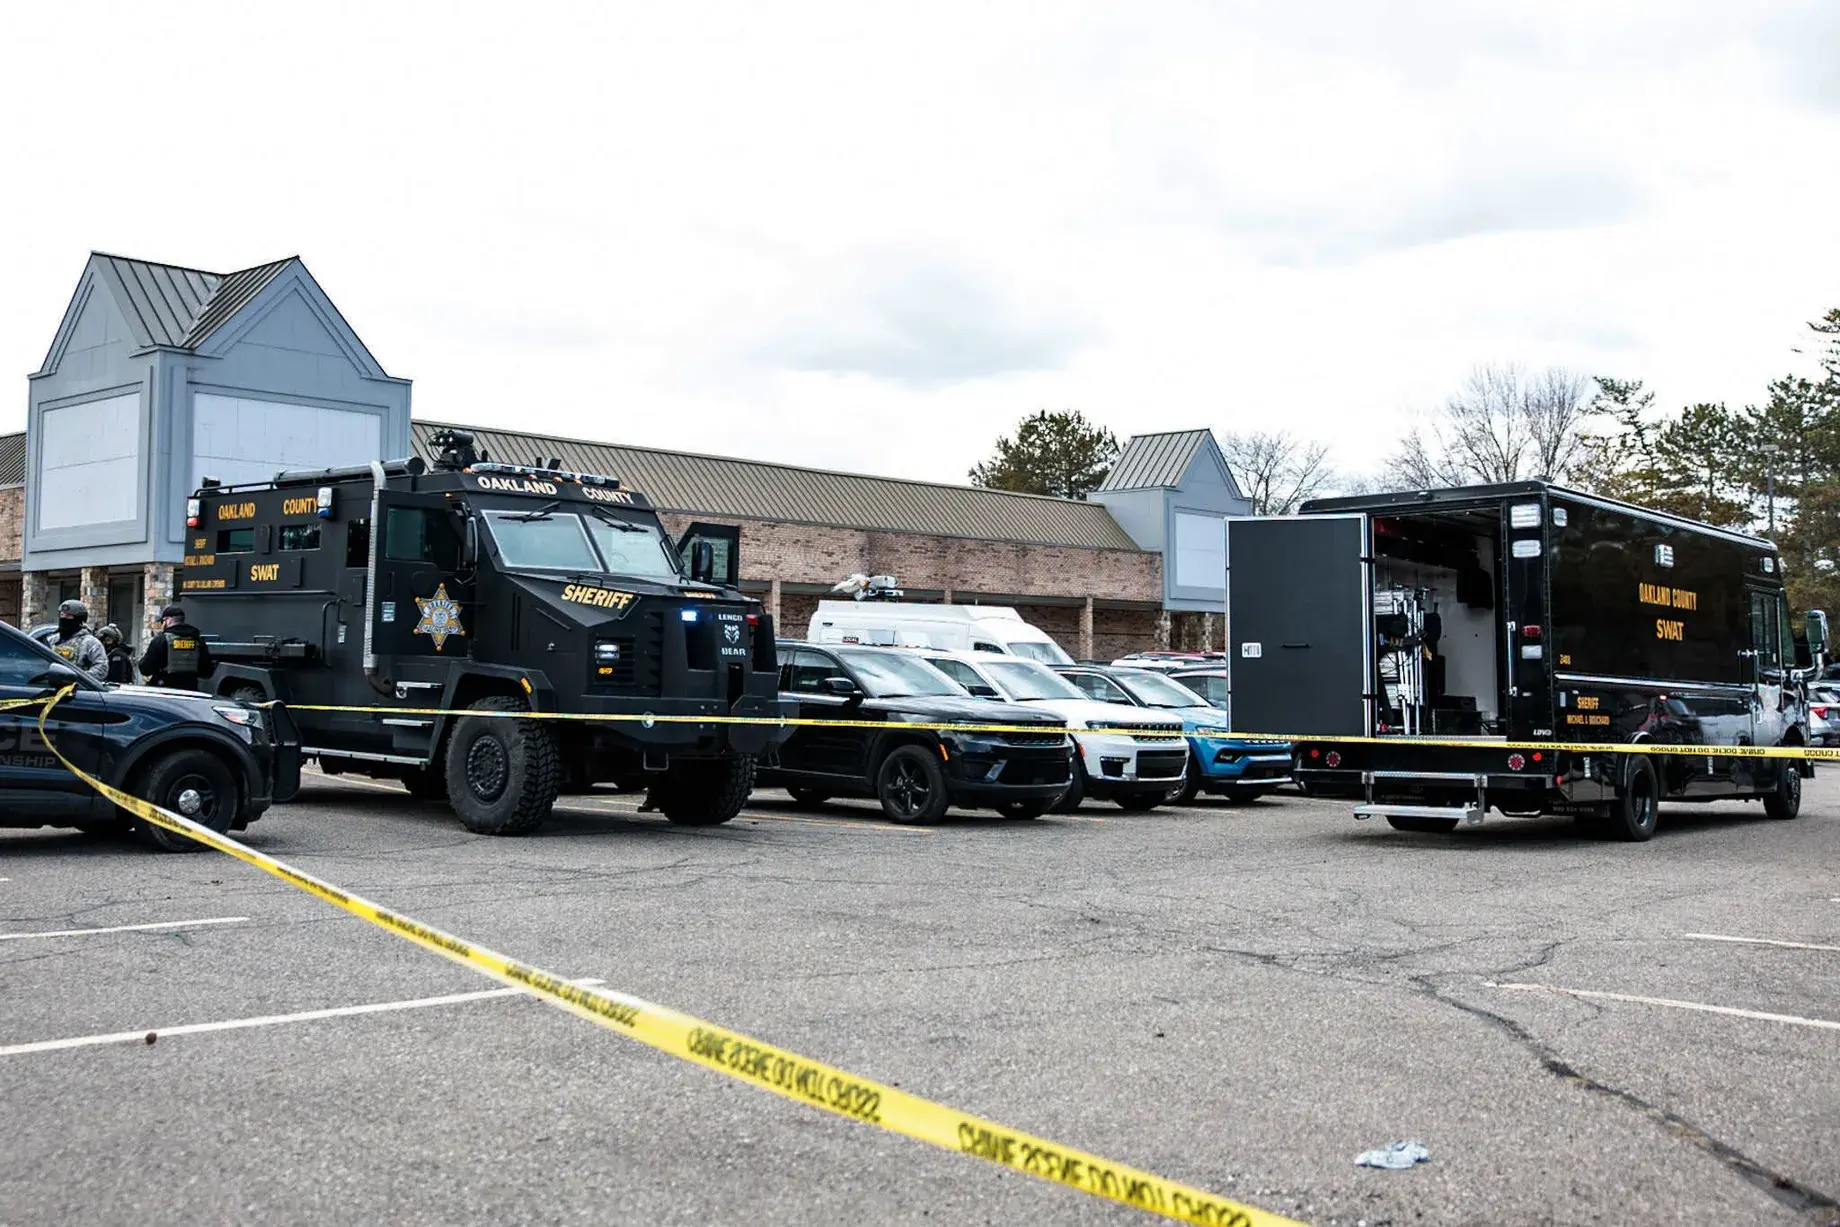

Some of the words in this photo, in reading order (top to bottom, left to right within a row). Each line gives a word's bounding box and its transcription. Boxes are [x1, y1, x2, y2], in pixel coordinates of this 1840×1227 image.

[477, 476, 558, 495] OAKLAND
[582, 487, 635, 505] COUNTY
[218, 502, 256, 520] OAKLAND
[283, 498, 318, 515] COUNTY
[251, 564, 279, 581] SWAT
[561, 584, 633, 609] SHERIFF
[1639, 582, 1670, 606] OAKLAND
[1672, 588, 1697, 611] COUNTY
[718, 613, 743, 621] LENCO
[1656, 619, 1684, 641] SWAT
[173, 639, 195, 649] SHERIFF
[1577, 696, 1599, 710] SHERIFF
